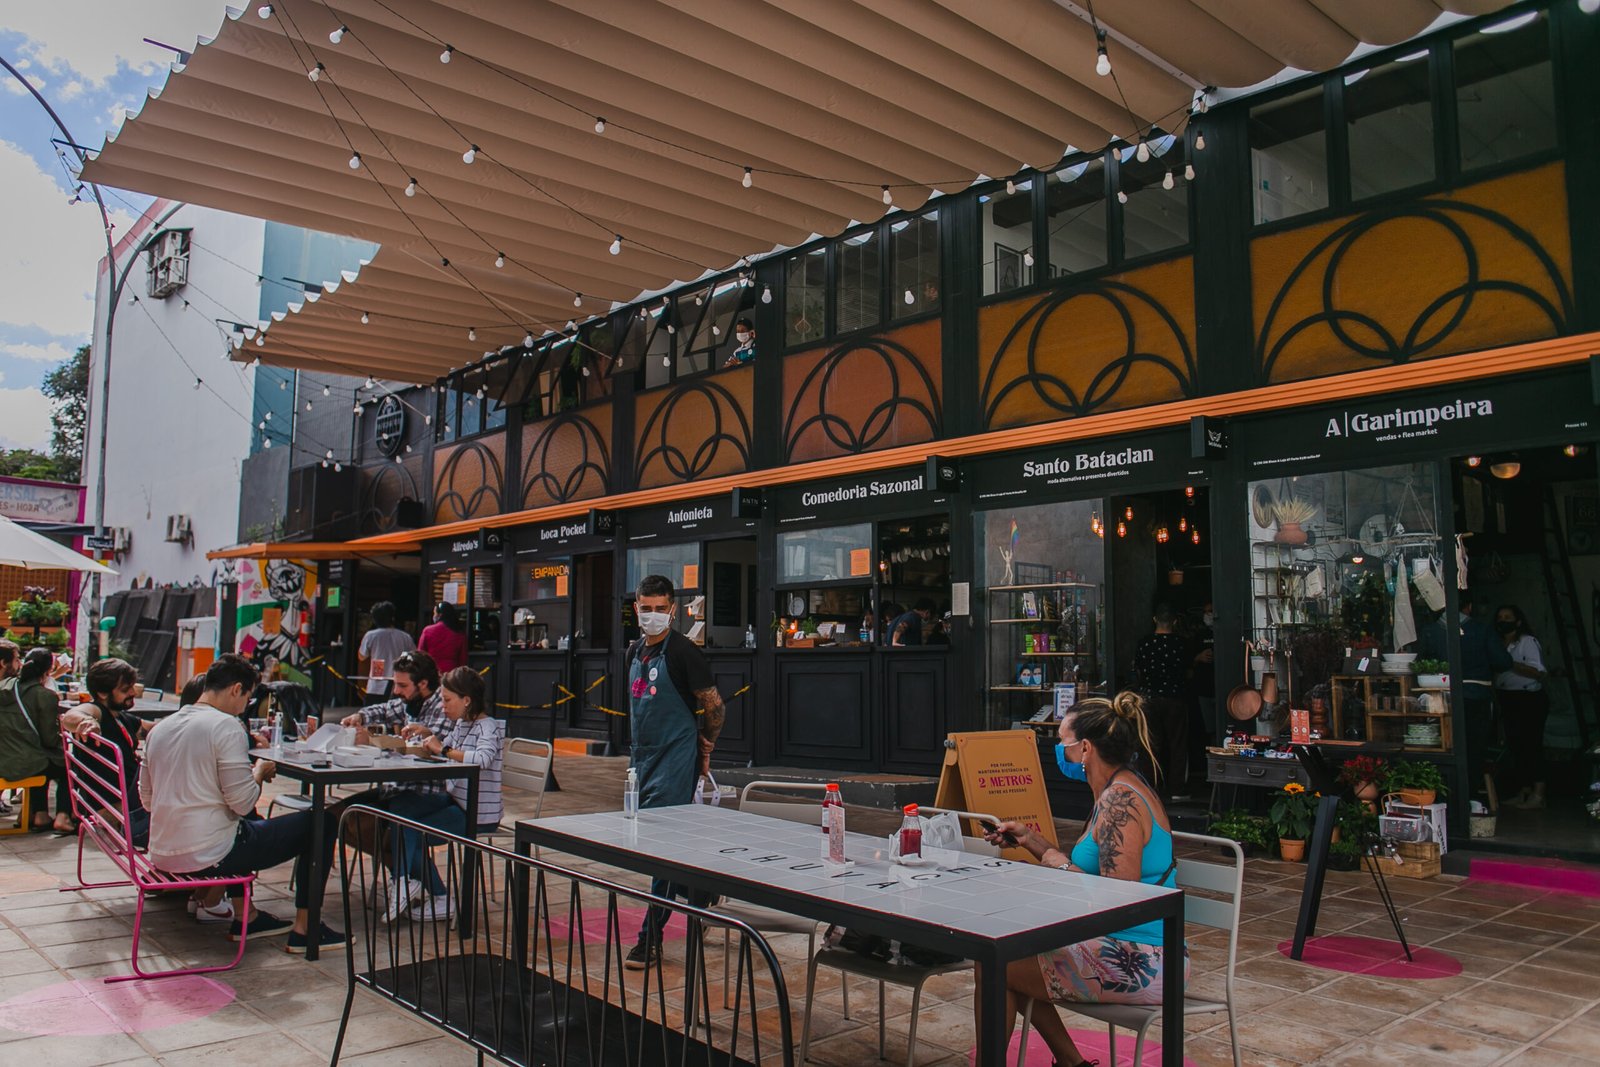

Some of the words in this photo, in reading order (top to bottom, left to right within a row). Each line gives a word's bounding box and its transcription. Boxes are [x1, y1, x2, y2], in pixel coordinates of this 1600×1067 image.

[1351, 399, 1493, 433] Garimpeira
[1375, 434, 1397, 442] vendas
[1402, 431, 1415, 439] flea
[1415, 428, 1438, 438] market
[1023, 457, 1070, 478] Santo
[1075, 447, 1154, 471] Bataclan
[1085, 472, 1107, 481] presentes
[1106, 469, 1130, 478] divertidos
[802, 484, 867, 506] Comedoria
[869, 475, 924, 497] Sazonal
[667, 506, 713, 524] Antonieta
[540, 529, 559, 540] Loca
[560, 522, 587, 537] Pocket
[978, 776, 987, 788] 2
[990, 774, 1033, 788] METROS
